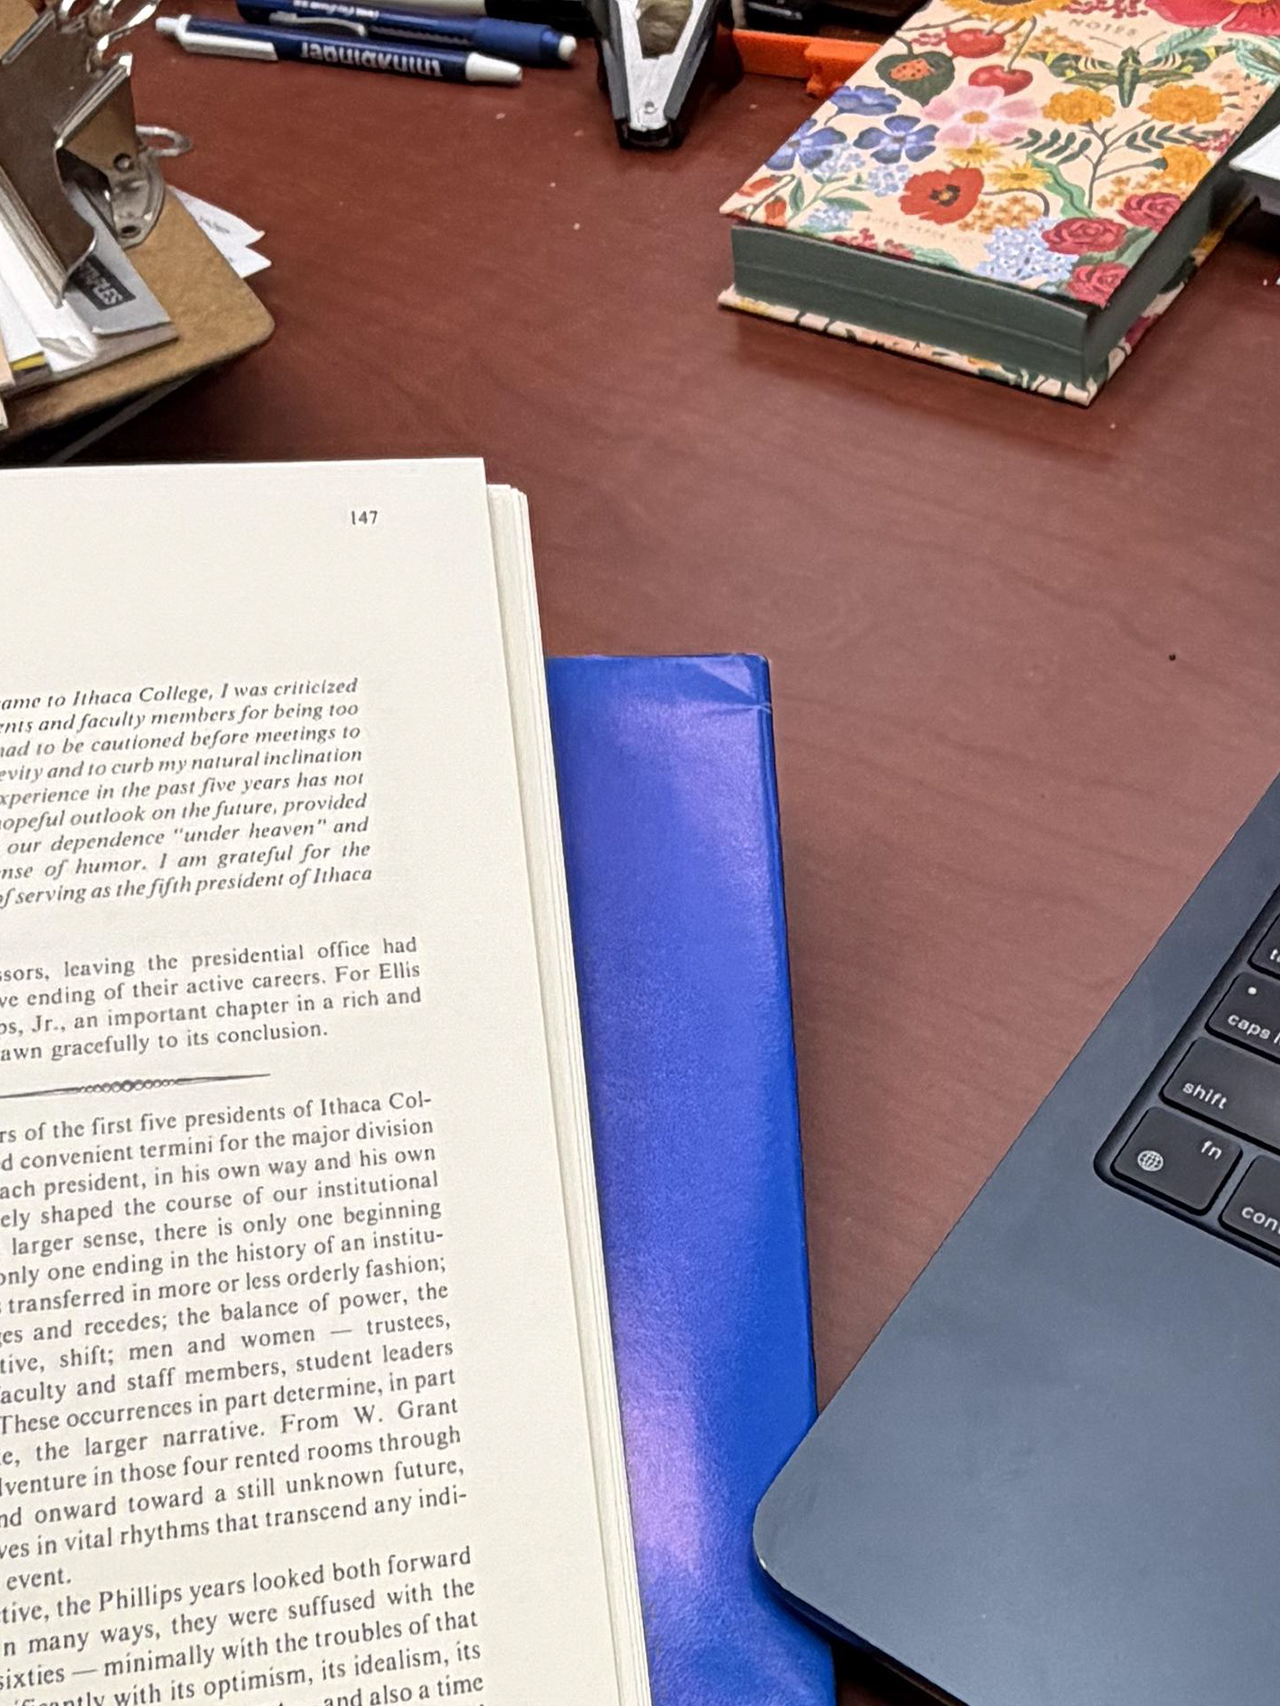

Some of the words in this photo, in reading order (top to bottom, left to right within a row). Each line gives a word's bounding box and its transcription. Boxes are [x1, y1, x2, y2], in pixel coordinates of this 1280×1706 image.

[1068, 17, 1138, 38] NOTES
[351, 510, 379, 527] 147
[48, 695, 67, 708] to
[73, 690, 133, 708] Ithaca
[139, 685, 213, 704] College,
[220, 683, 229, 699] I
[234, 686, 268, 698] was
[274, 677, 359, 697] criticized
[64, 957, 136, 978] leaving
[148, 954, 179, 972] the
[192, 944, 304, 973] presidential
[317, 941, 370, 959] office
[383, 936, 417, 954] had
[1227, 1014, 1271, 1040] caps
[1183, 1083, 1227, 1109] shift
[1201, 1140, 1222, 1160] fn
